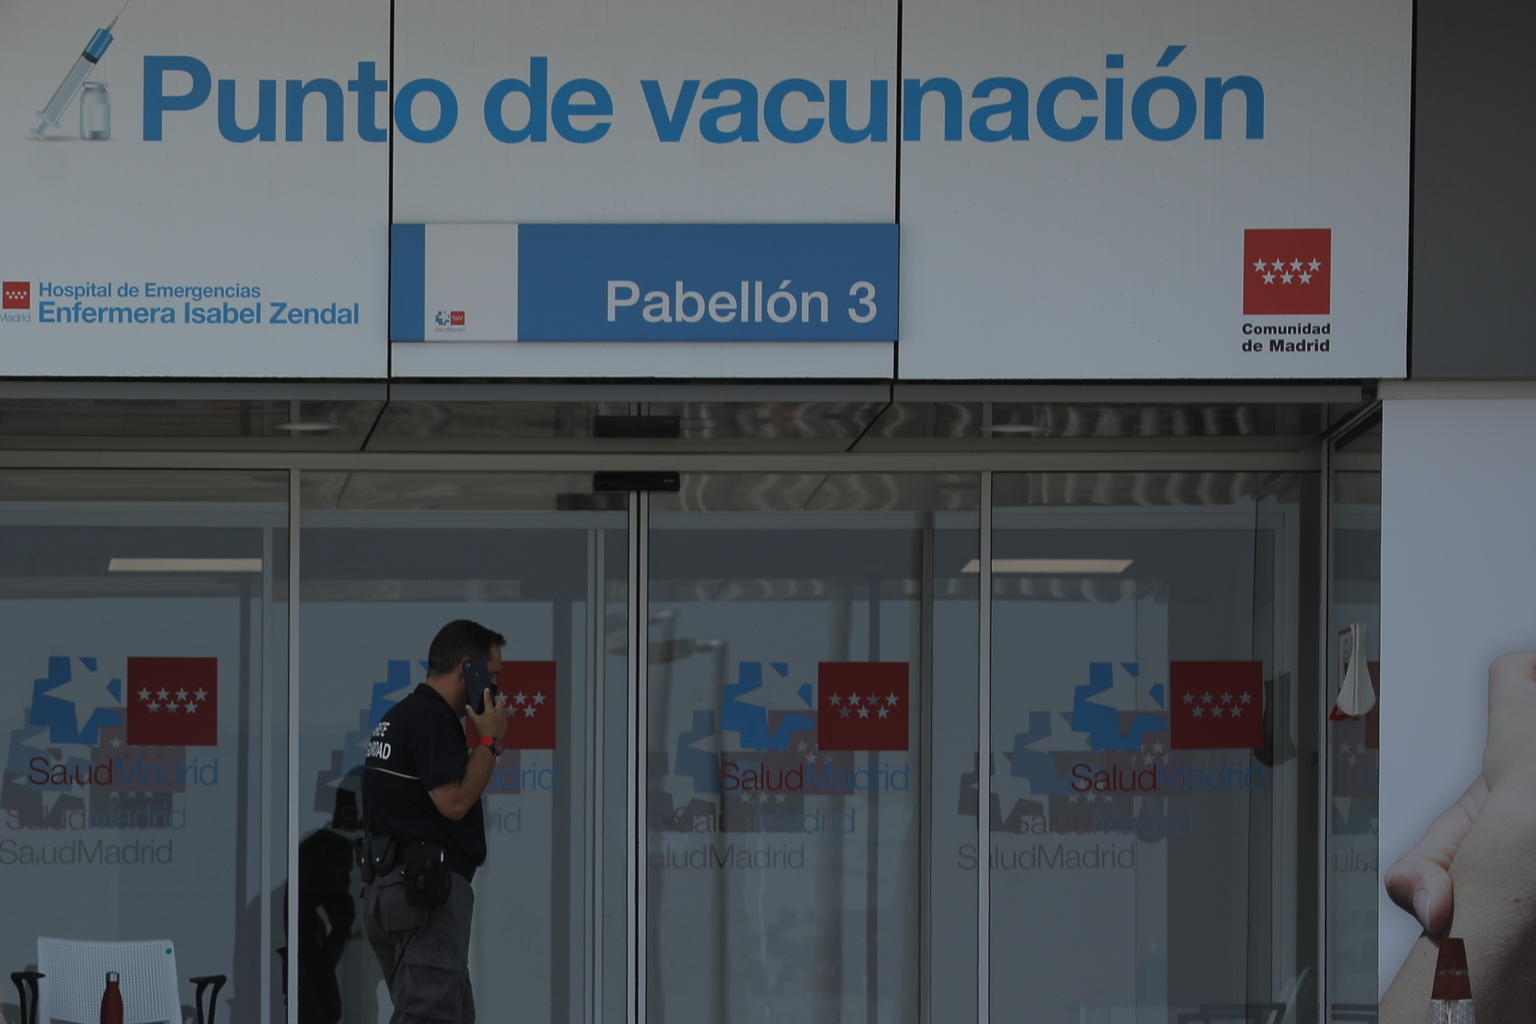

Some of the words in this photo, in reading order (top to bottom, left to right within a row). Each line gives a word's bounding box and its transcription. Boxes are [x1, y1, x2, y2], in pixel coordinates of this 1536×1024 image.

[142, 54, 459, 144] Punto
[484, 55, 613, 145] de
[640, 45, 1265, 144] vacunación
[38, 281, 112, 301] Hospital
[117, 282, 140, 298] de
[144, 282, 262, 302] Emergencias
[607, 278, 829, 325] Pabellón
[847, 280, 878, 325] 3
[38, 302, 176, 325] Enfermera
[184, 302, 262, 325] Isabel
[269, 302, 360, 325] Zendal
[1241, 323, 1331, 336] Comunidad
[1241, 339, 1264, 353] de
[1269, 339, 1331, 353] Madrid
[719, 762, 910, 791] SaludMadrid
[1070, 761, 1265, 792] SaludMadrid
